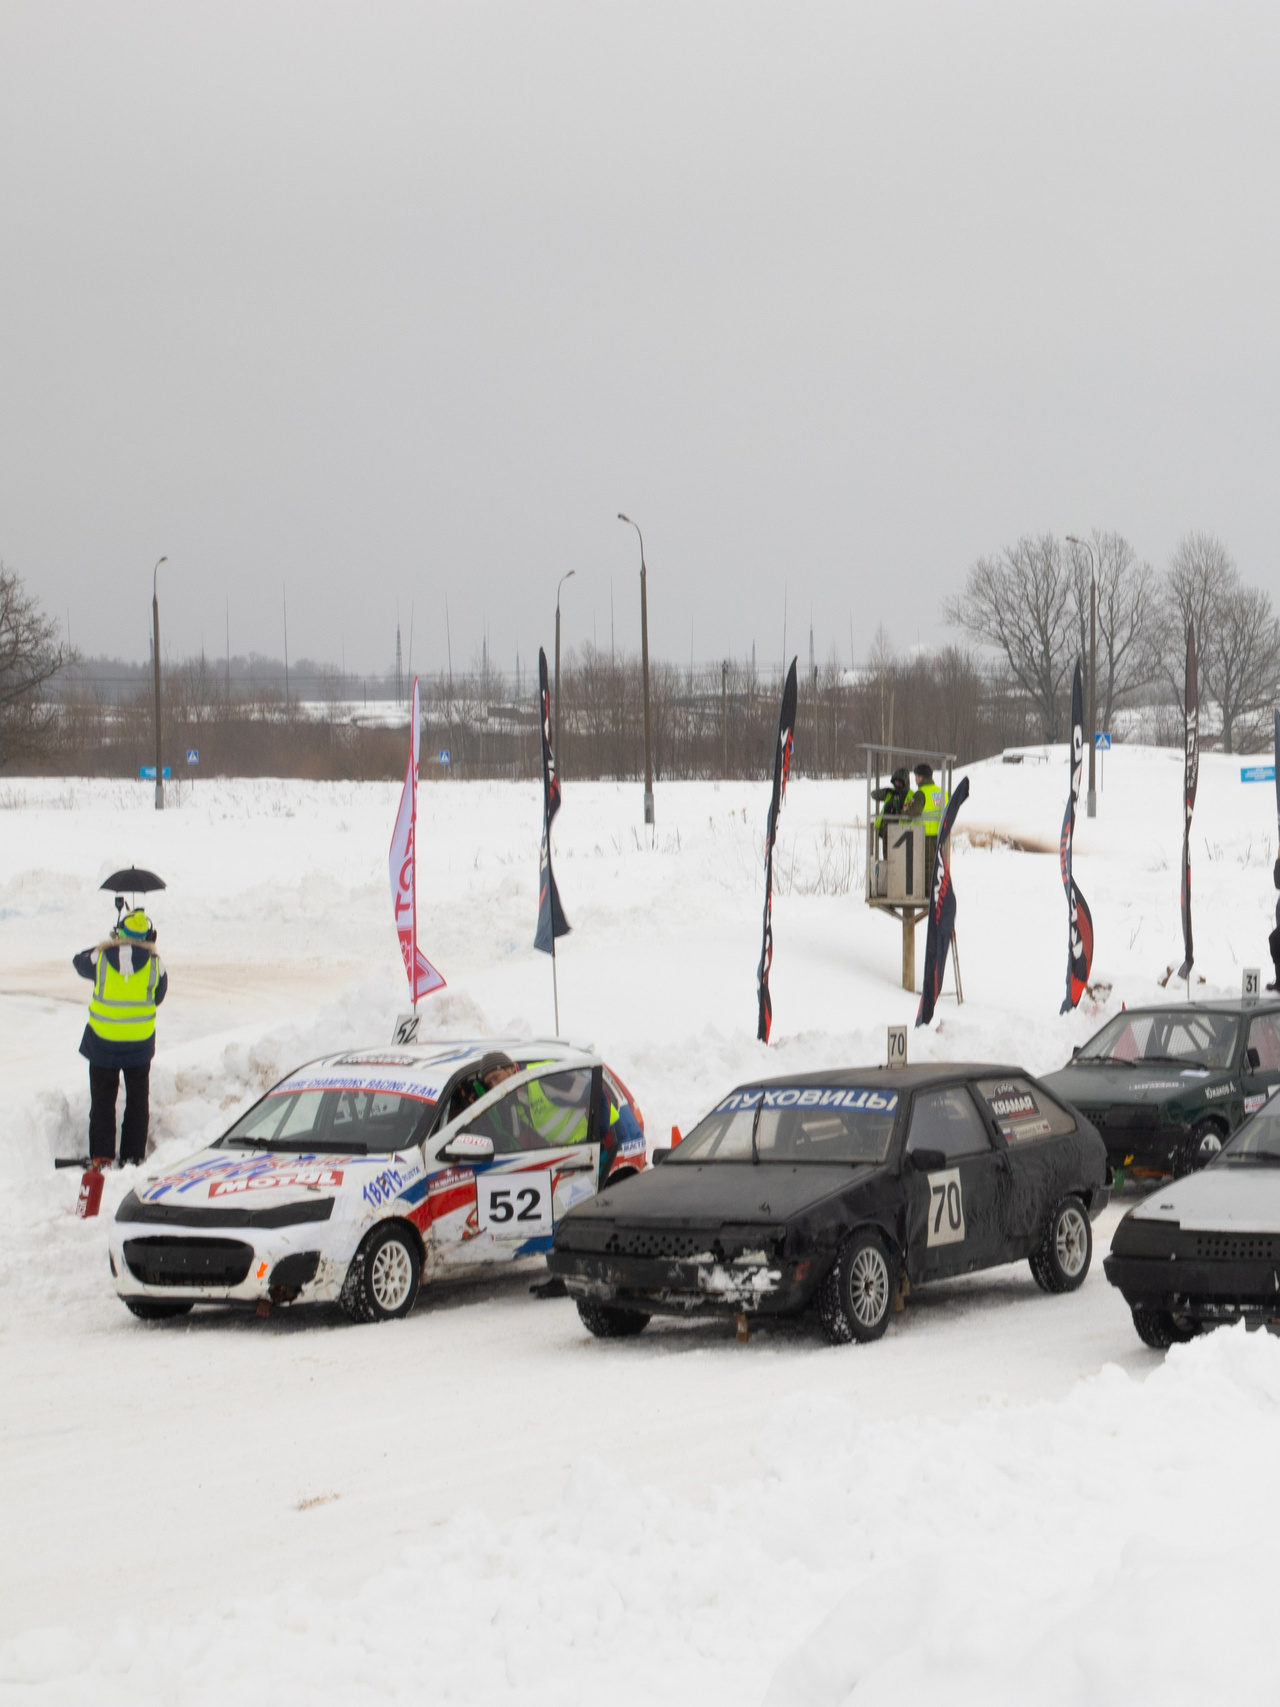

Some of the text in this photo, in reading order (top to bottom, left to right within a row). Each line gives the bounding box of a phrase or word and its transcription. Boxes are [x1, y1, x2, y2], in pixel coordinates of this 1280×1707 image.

[891, 830, 914, 896] 1
[1246, 974, 1258, 993] 31
[396, 1017, 420, 1046] 52
[889, 1032, 905, 1056] 70
[307, 1077, 364, 1089] CHAMPIONS
[365, 1078, 407, 1092] RACING
[406, 1081, 439, 1099] TEAM
[992, 1095, 1034, 1116] KRAMAR
[213, 1171, 338, 1195] MOTUL
[488, 1188, 542, 1223] 52
[931, 1181, 962, 1235] 70
